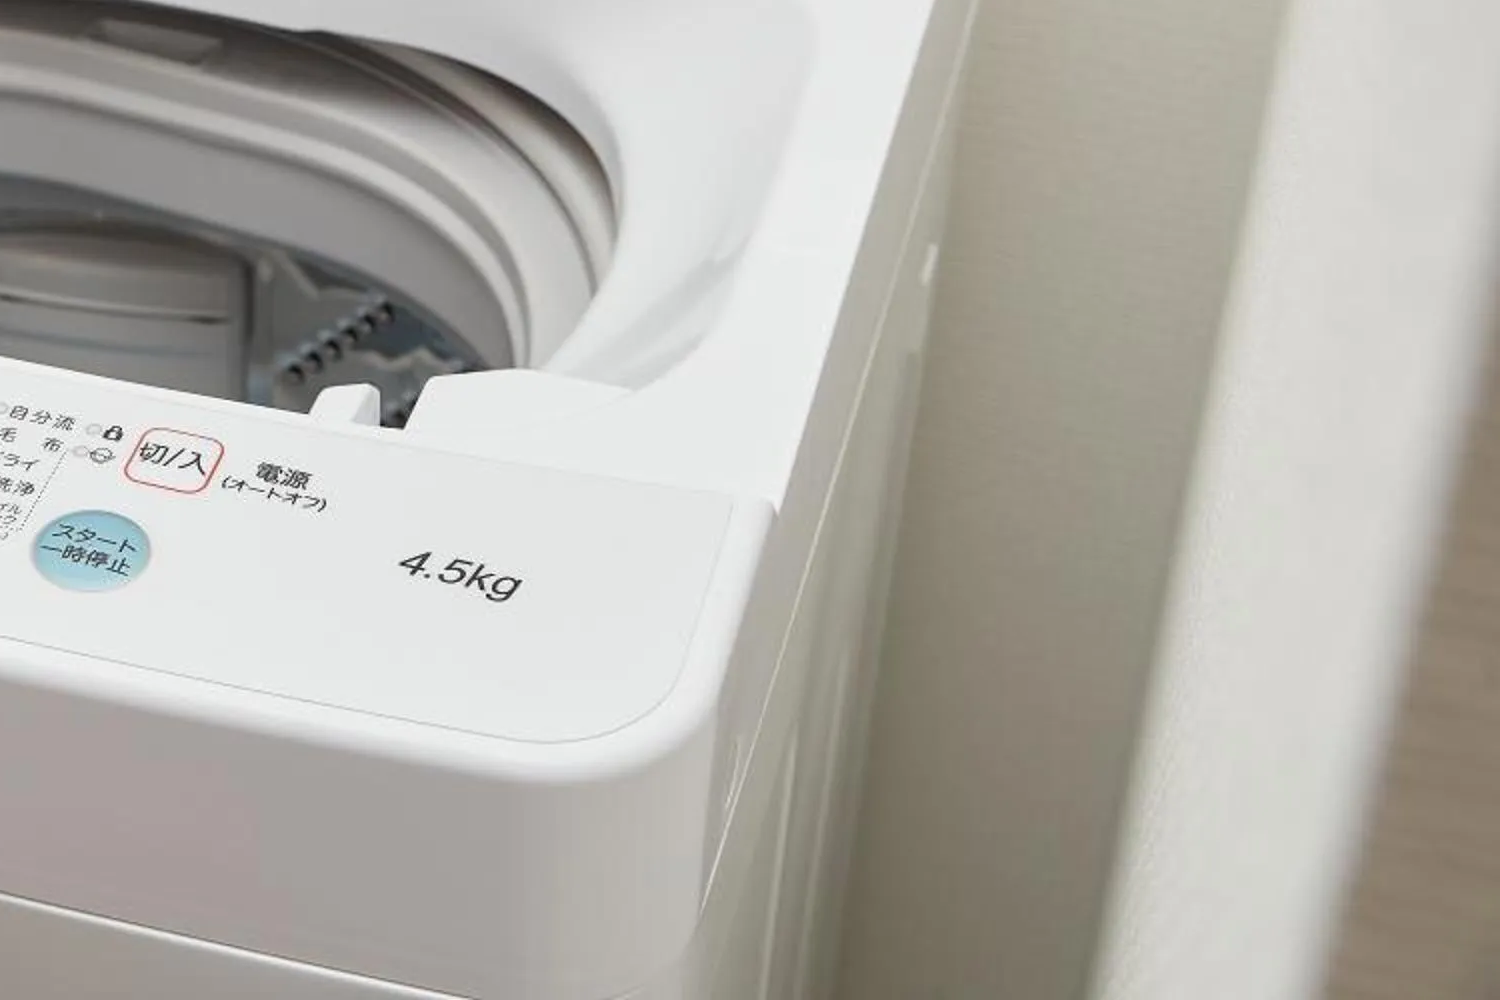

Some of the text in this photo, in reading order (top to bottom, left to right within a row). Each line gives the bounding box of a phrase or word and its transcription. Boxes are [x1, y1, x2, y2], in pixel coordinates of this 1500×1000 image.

[9, 404, 77, 432] 自分流
[139, 442, 206, 476] 切/入
[256, 462, 314, 491] 電源
[221, 474, 328, 513] (オートオフ)
[51, 524, 138, 553] スタート
[40, 544, 131, 577] 一時停止
[398, 551, 523, 602] 4.5kg
